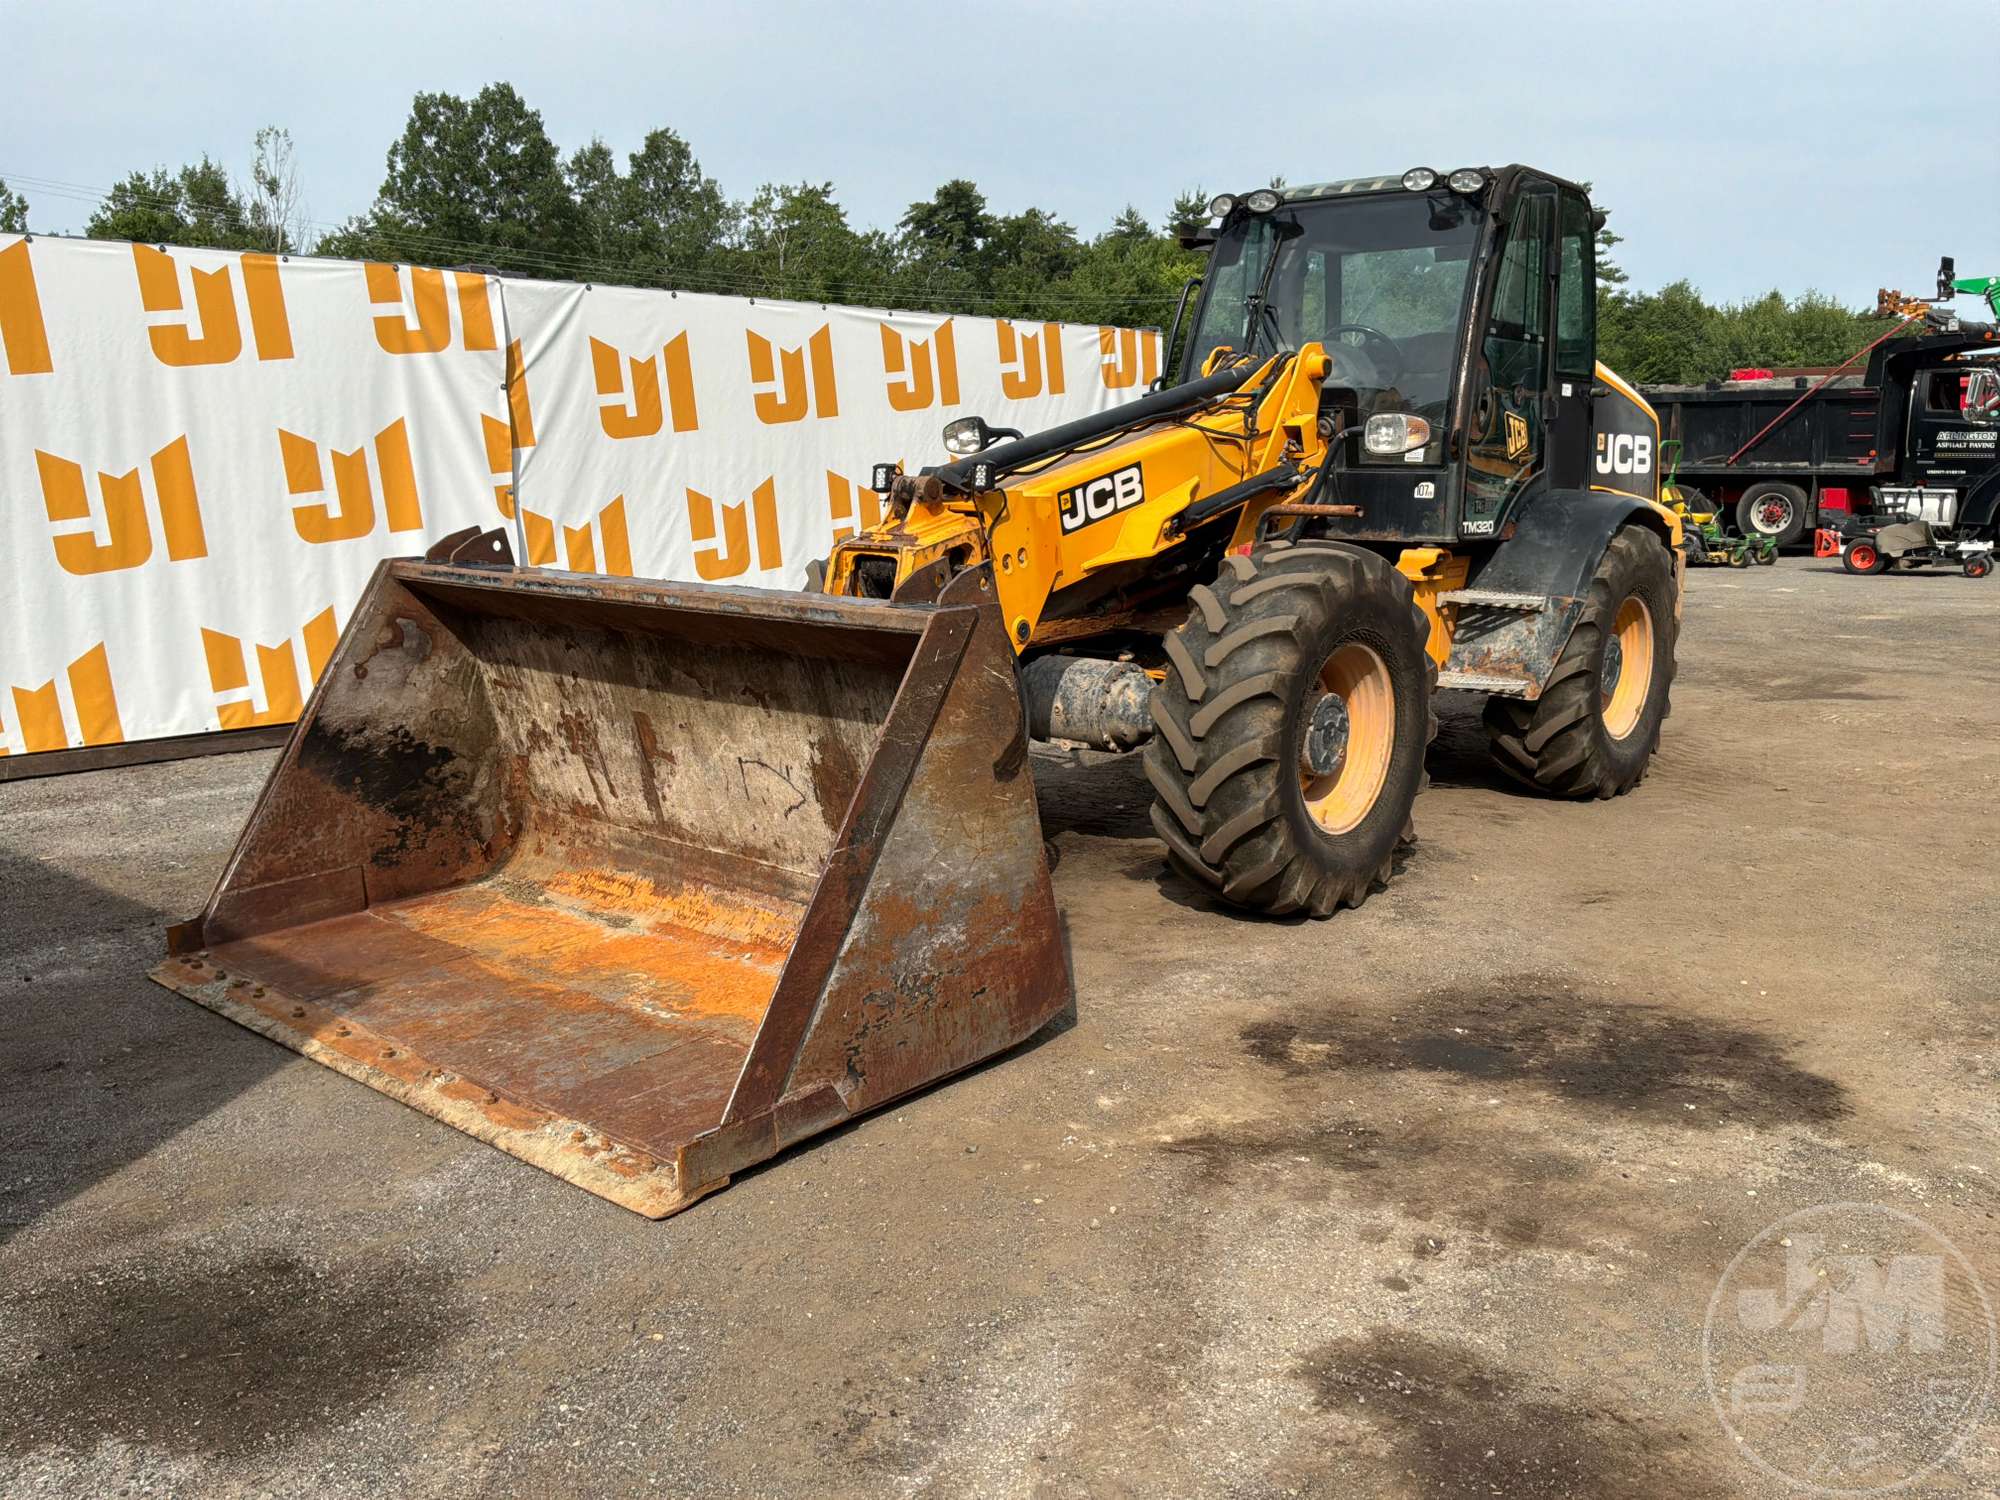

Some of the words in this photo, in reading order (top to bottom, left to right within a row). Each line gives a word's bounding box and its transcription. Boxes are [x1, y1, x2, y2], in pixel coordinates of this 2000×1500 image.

[1508, 416, 1528, 455] JCB
[1596, 432, 1652, 474] JCB
[1936, 431, 1998, 441] ARLINGTON
[1062, 467, 1143, 530] JCB
[1462, 520, 1494, 535] TM320
